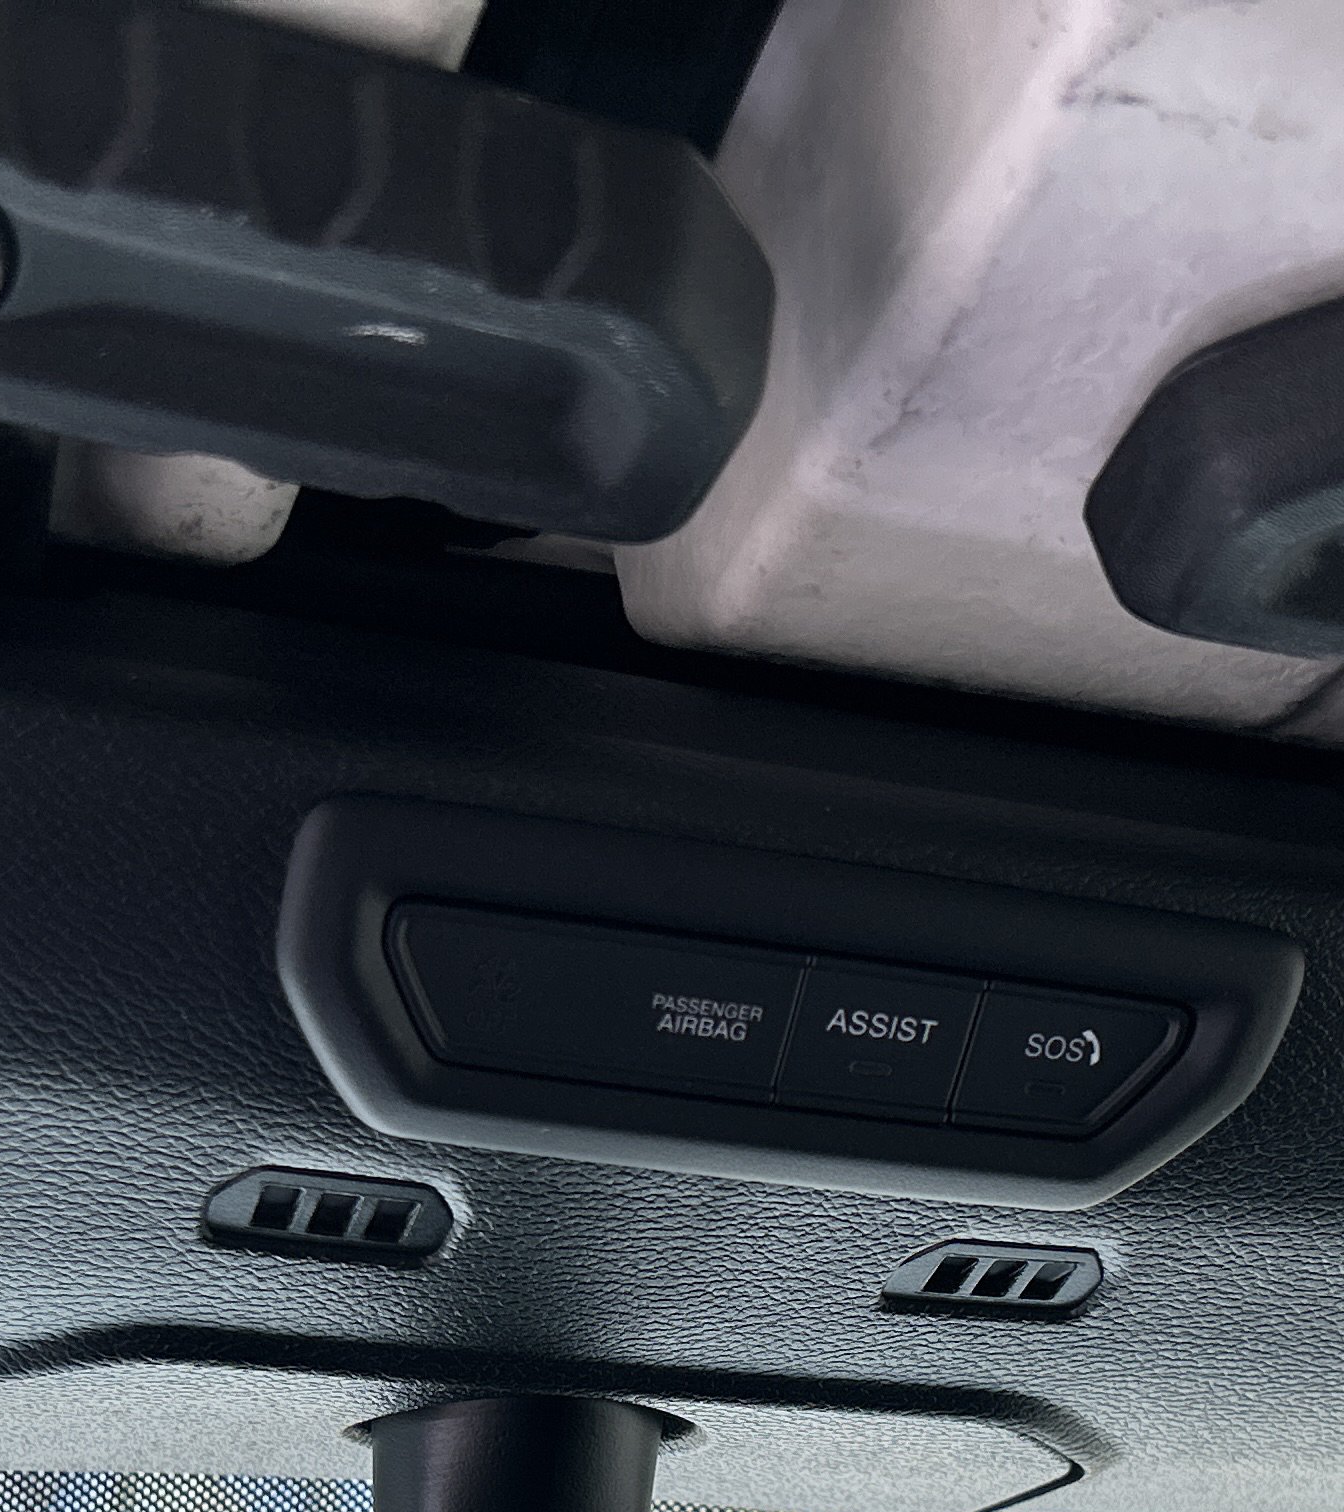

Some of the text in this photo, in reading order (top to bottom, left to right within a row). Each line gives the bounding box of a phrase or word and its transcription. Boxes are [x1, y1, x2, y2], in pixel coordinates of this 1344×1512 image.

[652, 994, 763, 1022] PASSENGER
[657, 1014, 747, 1042] AIRBAG
[826, 1008, 939, 1045] ASSIST
[1025, 1033, 1086, 1063] SOS
